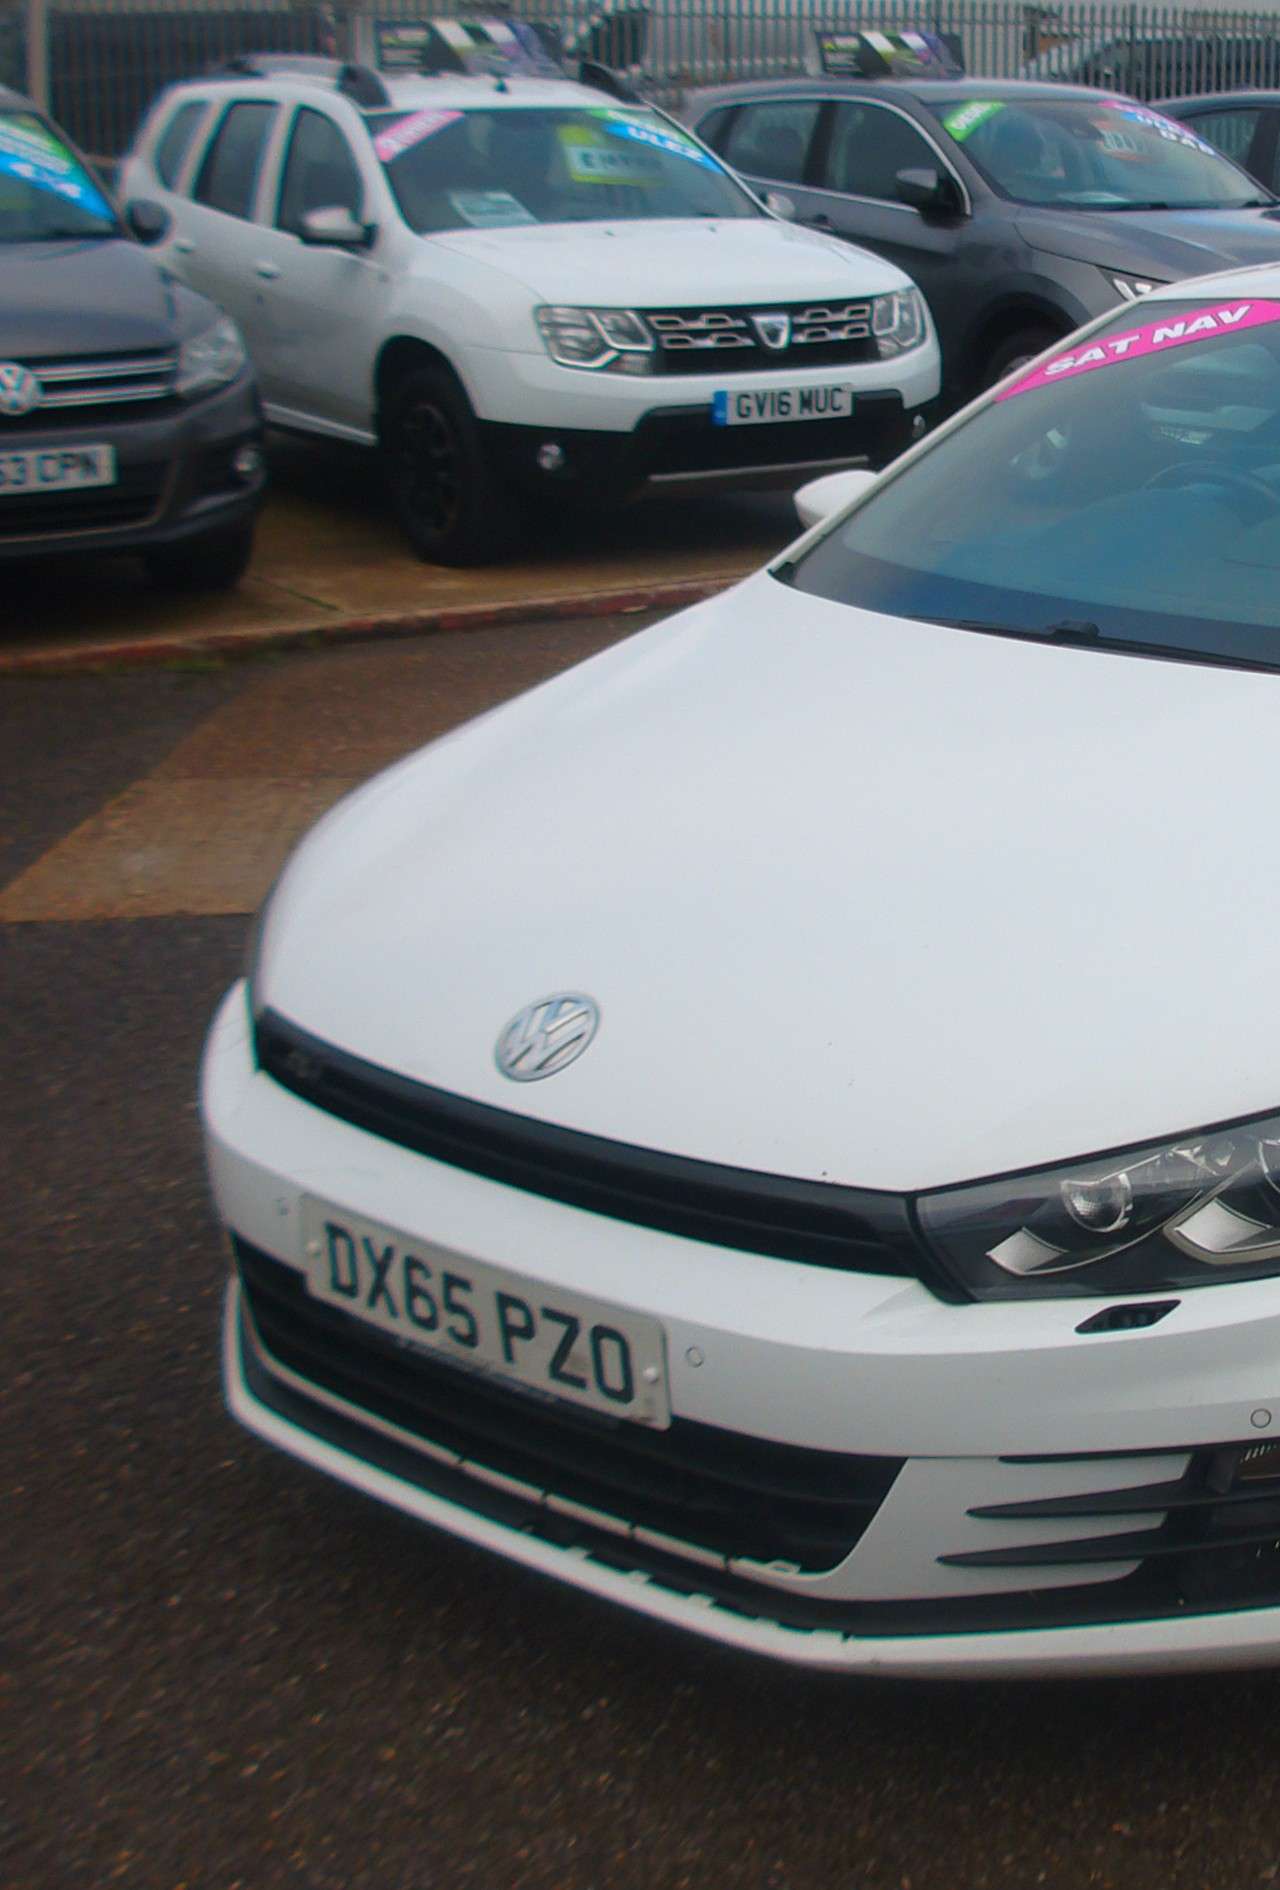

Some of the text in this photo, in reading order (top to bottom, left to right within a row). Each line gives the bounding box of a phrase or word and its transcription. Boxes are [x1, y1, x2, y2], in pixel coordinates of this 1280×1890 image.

[1044, 304, 1252, 376] SAT NAV
[736, 387, 844, 419] GV16 MUC
[323, 1219, 480, 1350] DX65
